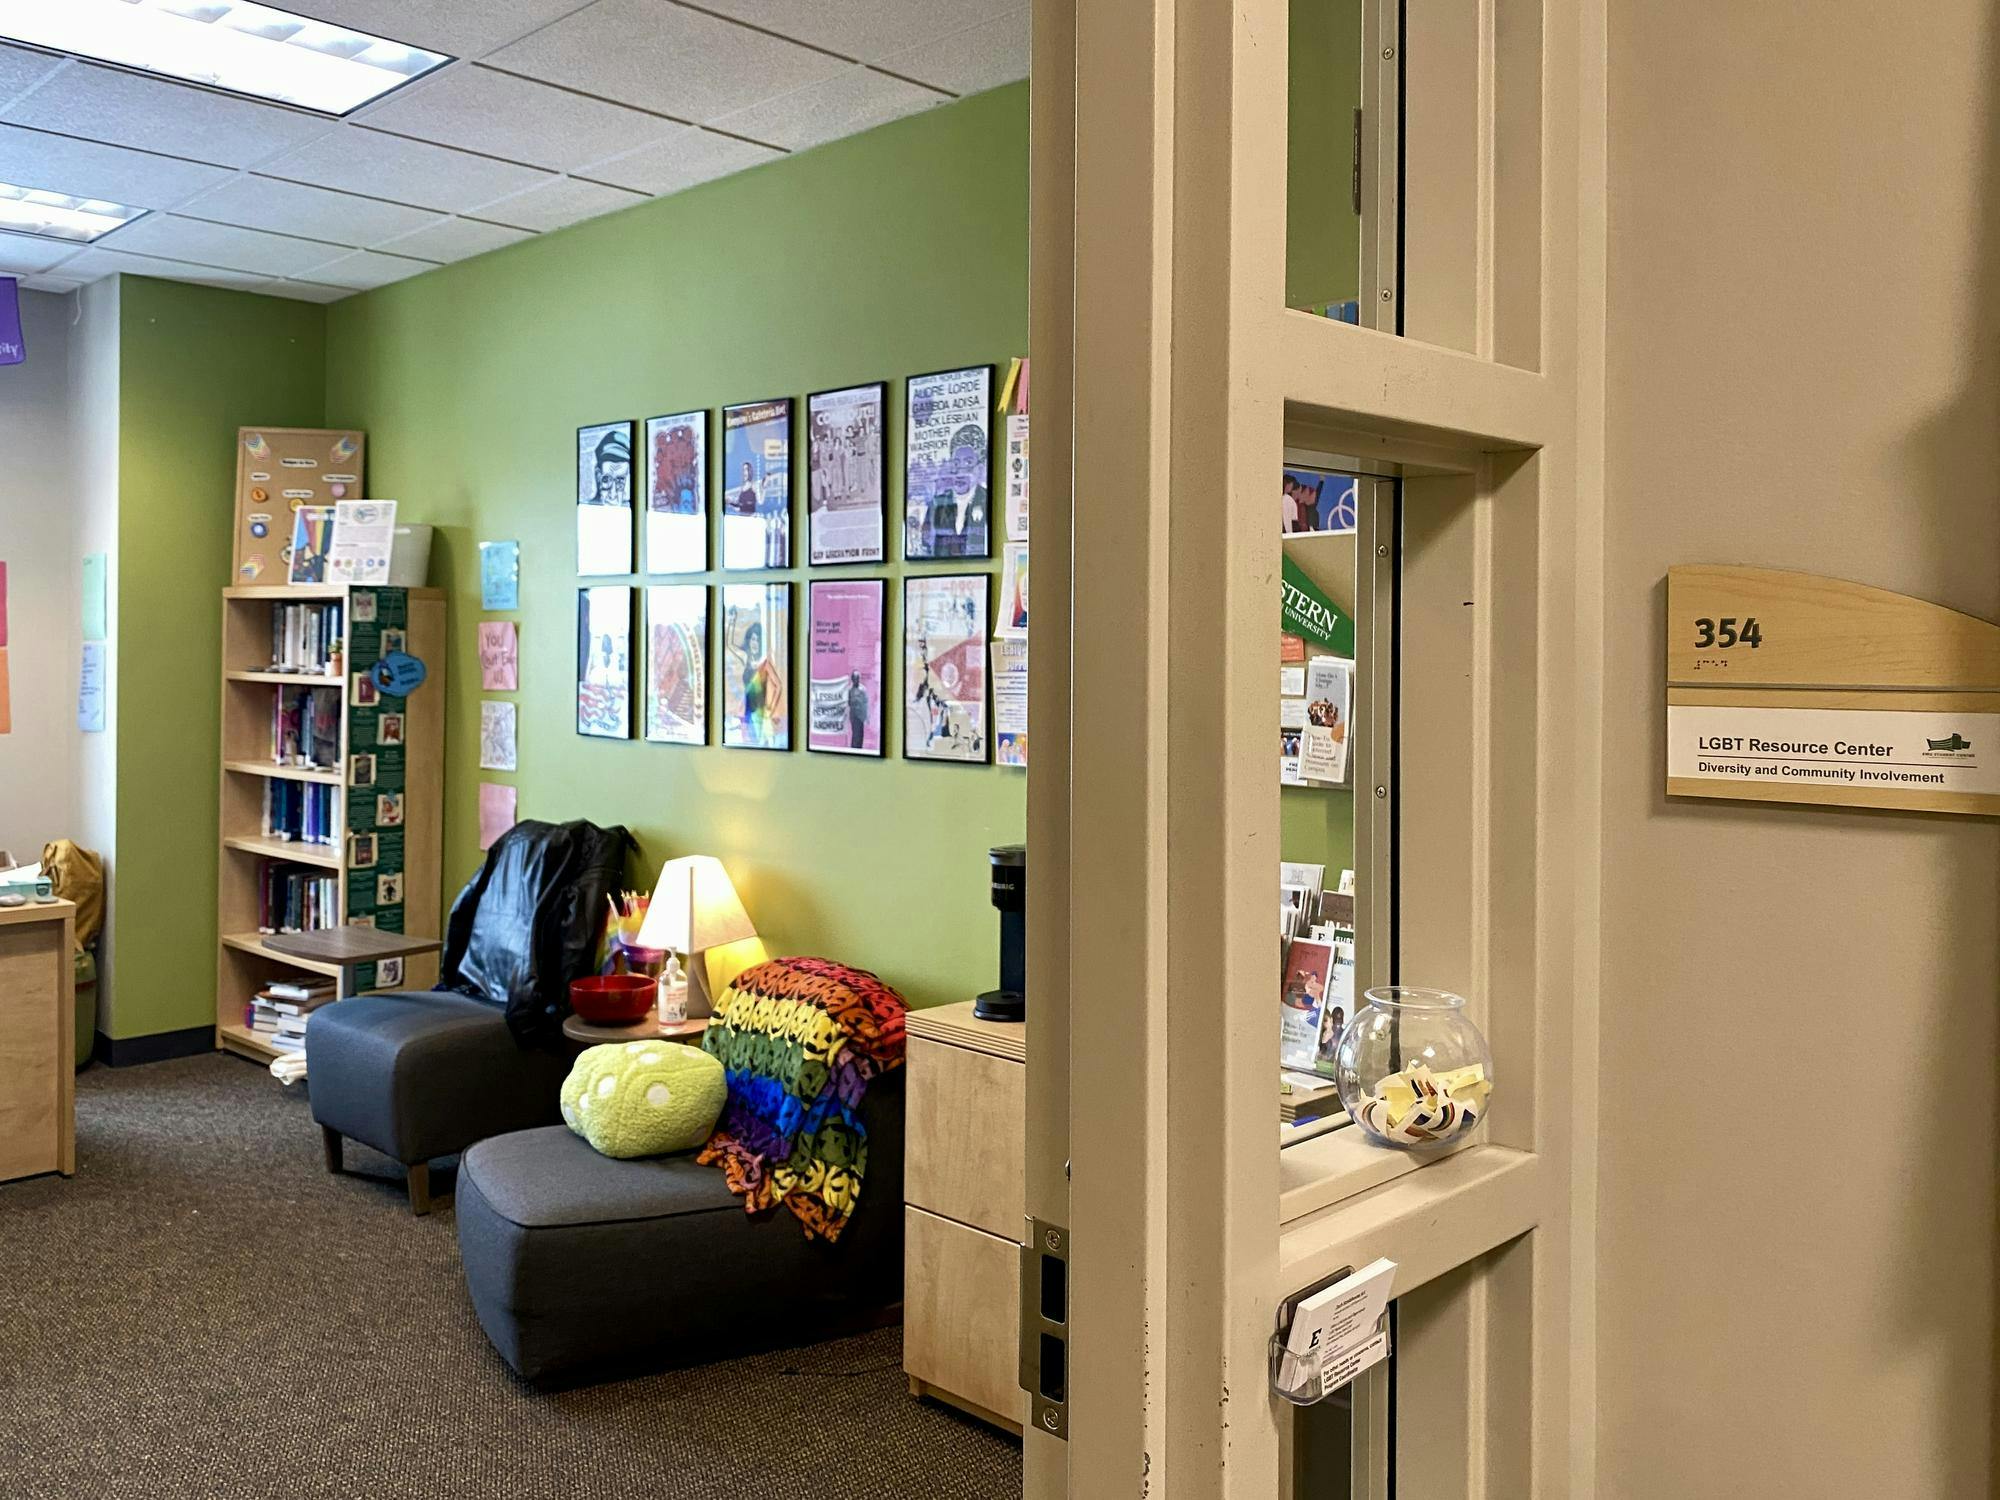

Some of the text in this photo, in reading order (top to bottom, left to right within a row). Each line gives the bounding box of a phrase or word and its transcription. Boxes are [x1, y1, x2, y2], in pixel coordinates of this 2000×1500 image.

[914, 379, 981, 399] AUDRE LORDE
[941, 412, 979, 425] LESBIAN
[914, 426, 951, 440] MOTHER
[917, 450, 938, 461] POET
[1284, 606, 1332, 640] UNIVERSITY
[1694, 617, 1763, 648] 354
[1698, 736, 1894, 757] LGBT Resource Center
[1698, 762, 1945, 784] Diversity and Community Involvement
[1309, 1327, 1323, 1349] E
